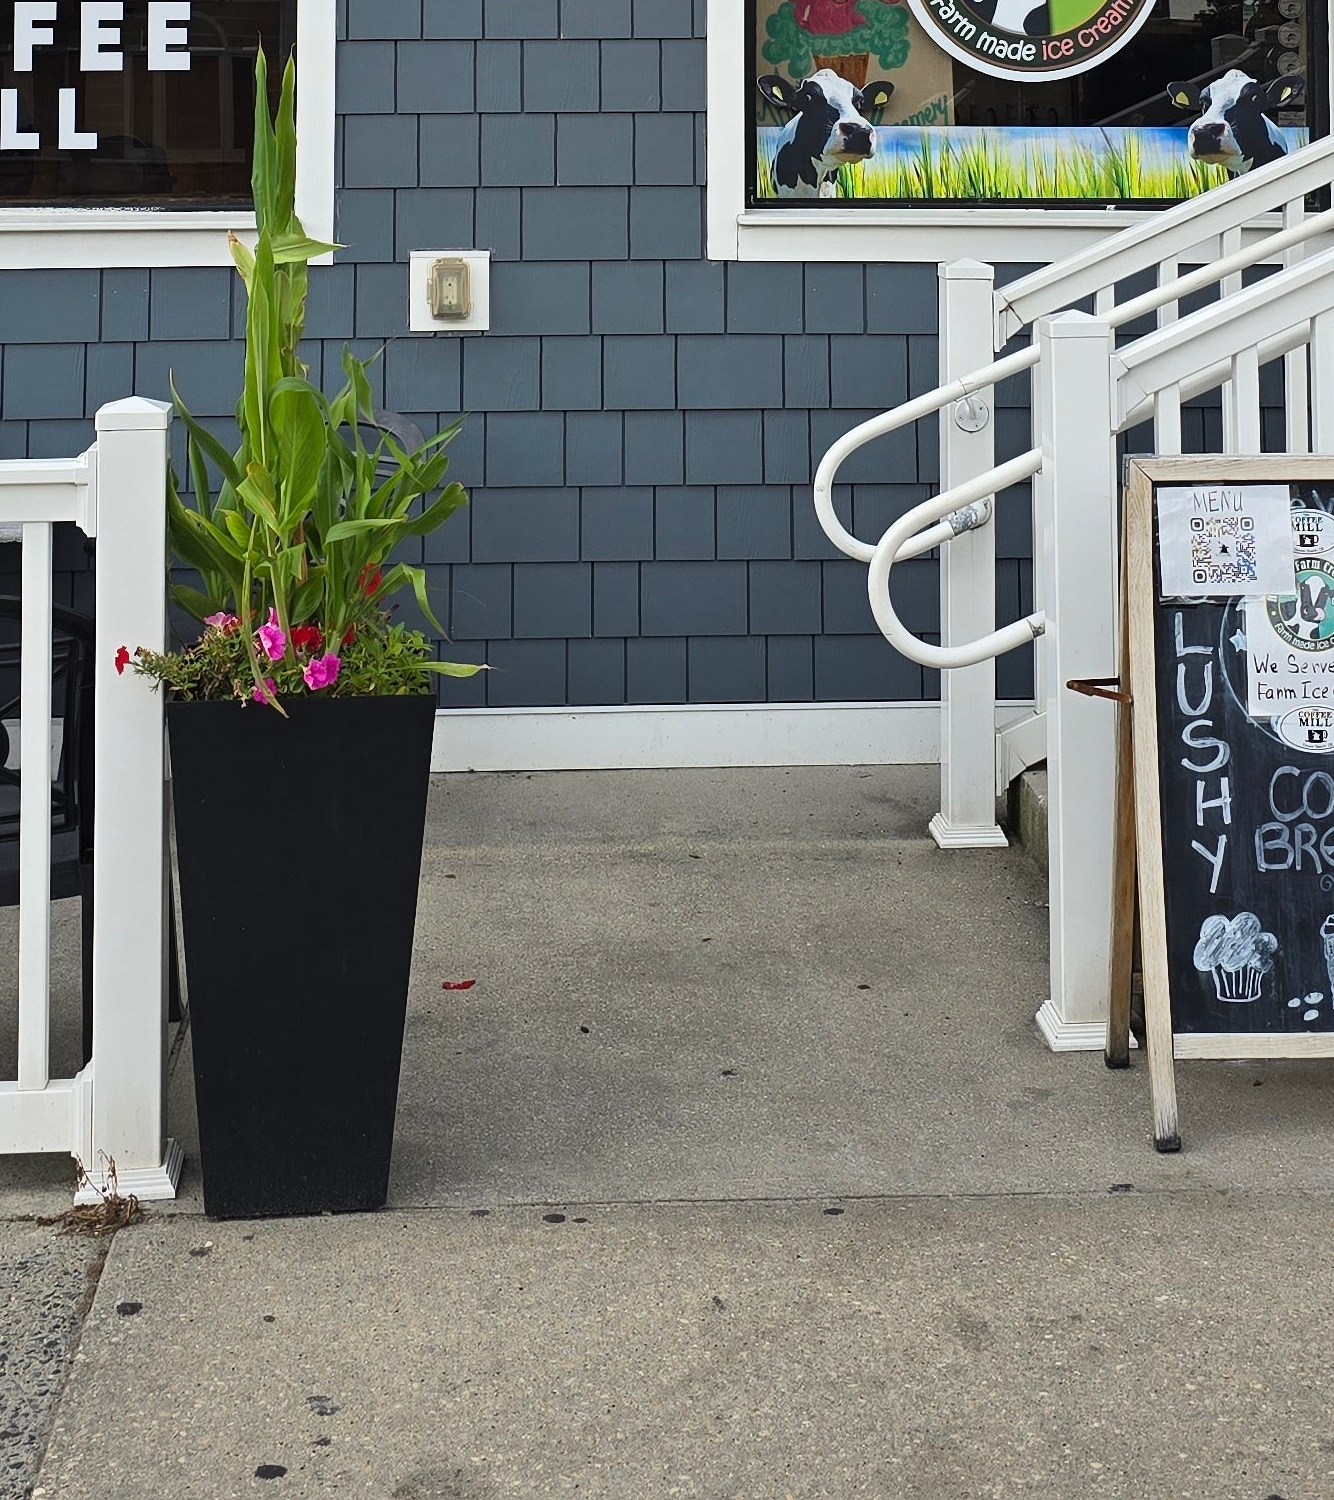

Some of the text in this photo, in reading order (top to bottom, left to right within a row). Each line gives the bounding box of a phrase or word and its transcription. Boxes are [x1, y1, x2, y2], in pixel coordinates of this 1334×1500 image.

[975, 31, 1037, 61] made
[1041, 38, 1075, 60] ice
[1193, 490, 1243, 513] MENU
[1253, 653, 1279, 674] We
[1301, 681, 1329, 699] Ice
[1299, 718, 1333, 727] MILL
[1174, 610, 1232, 894] LUSHY
